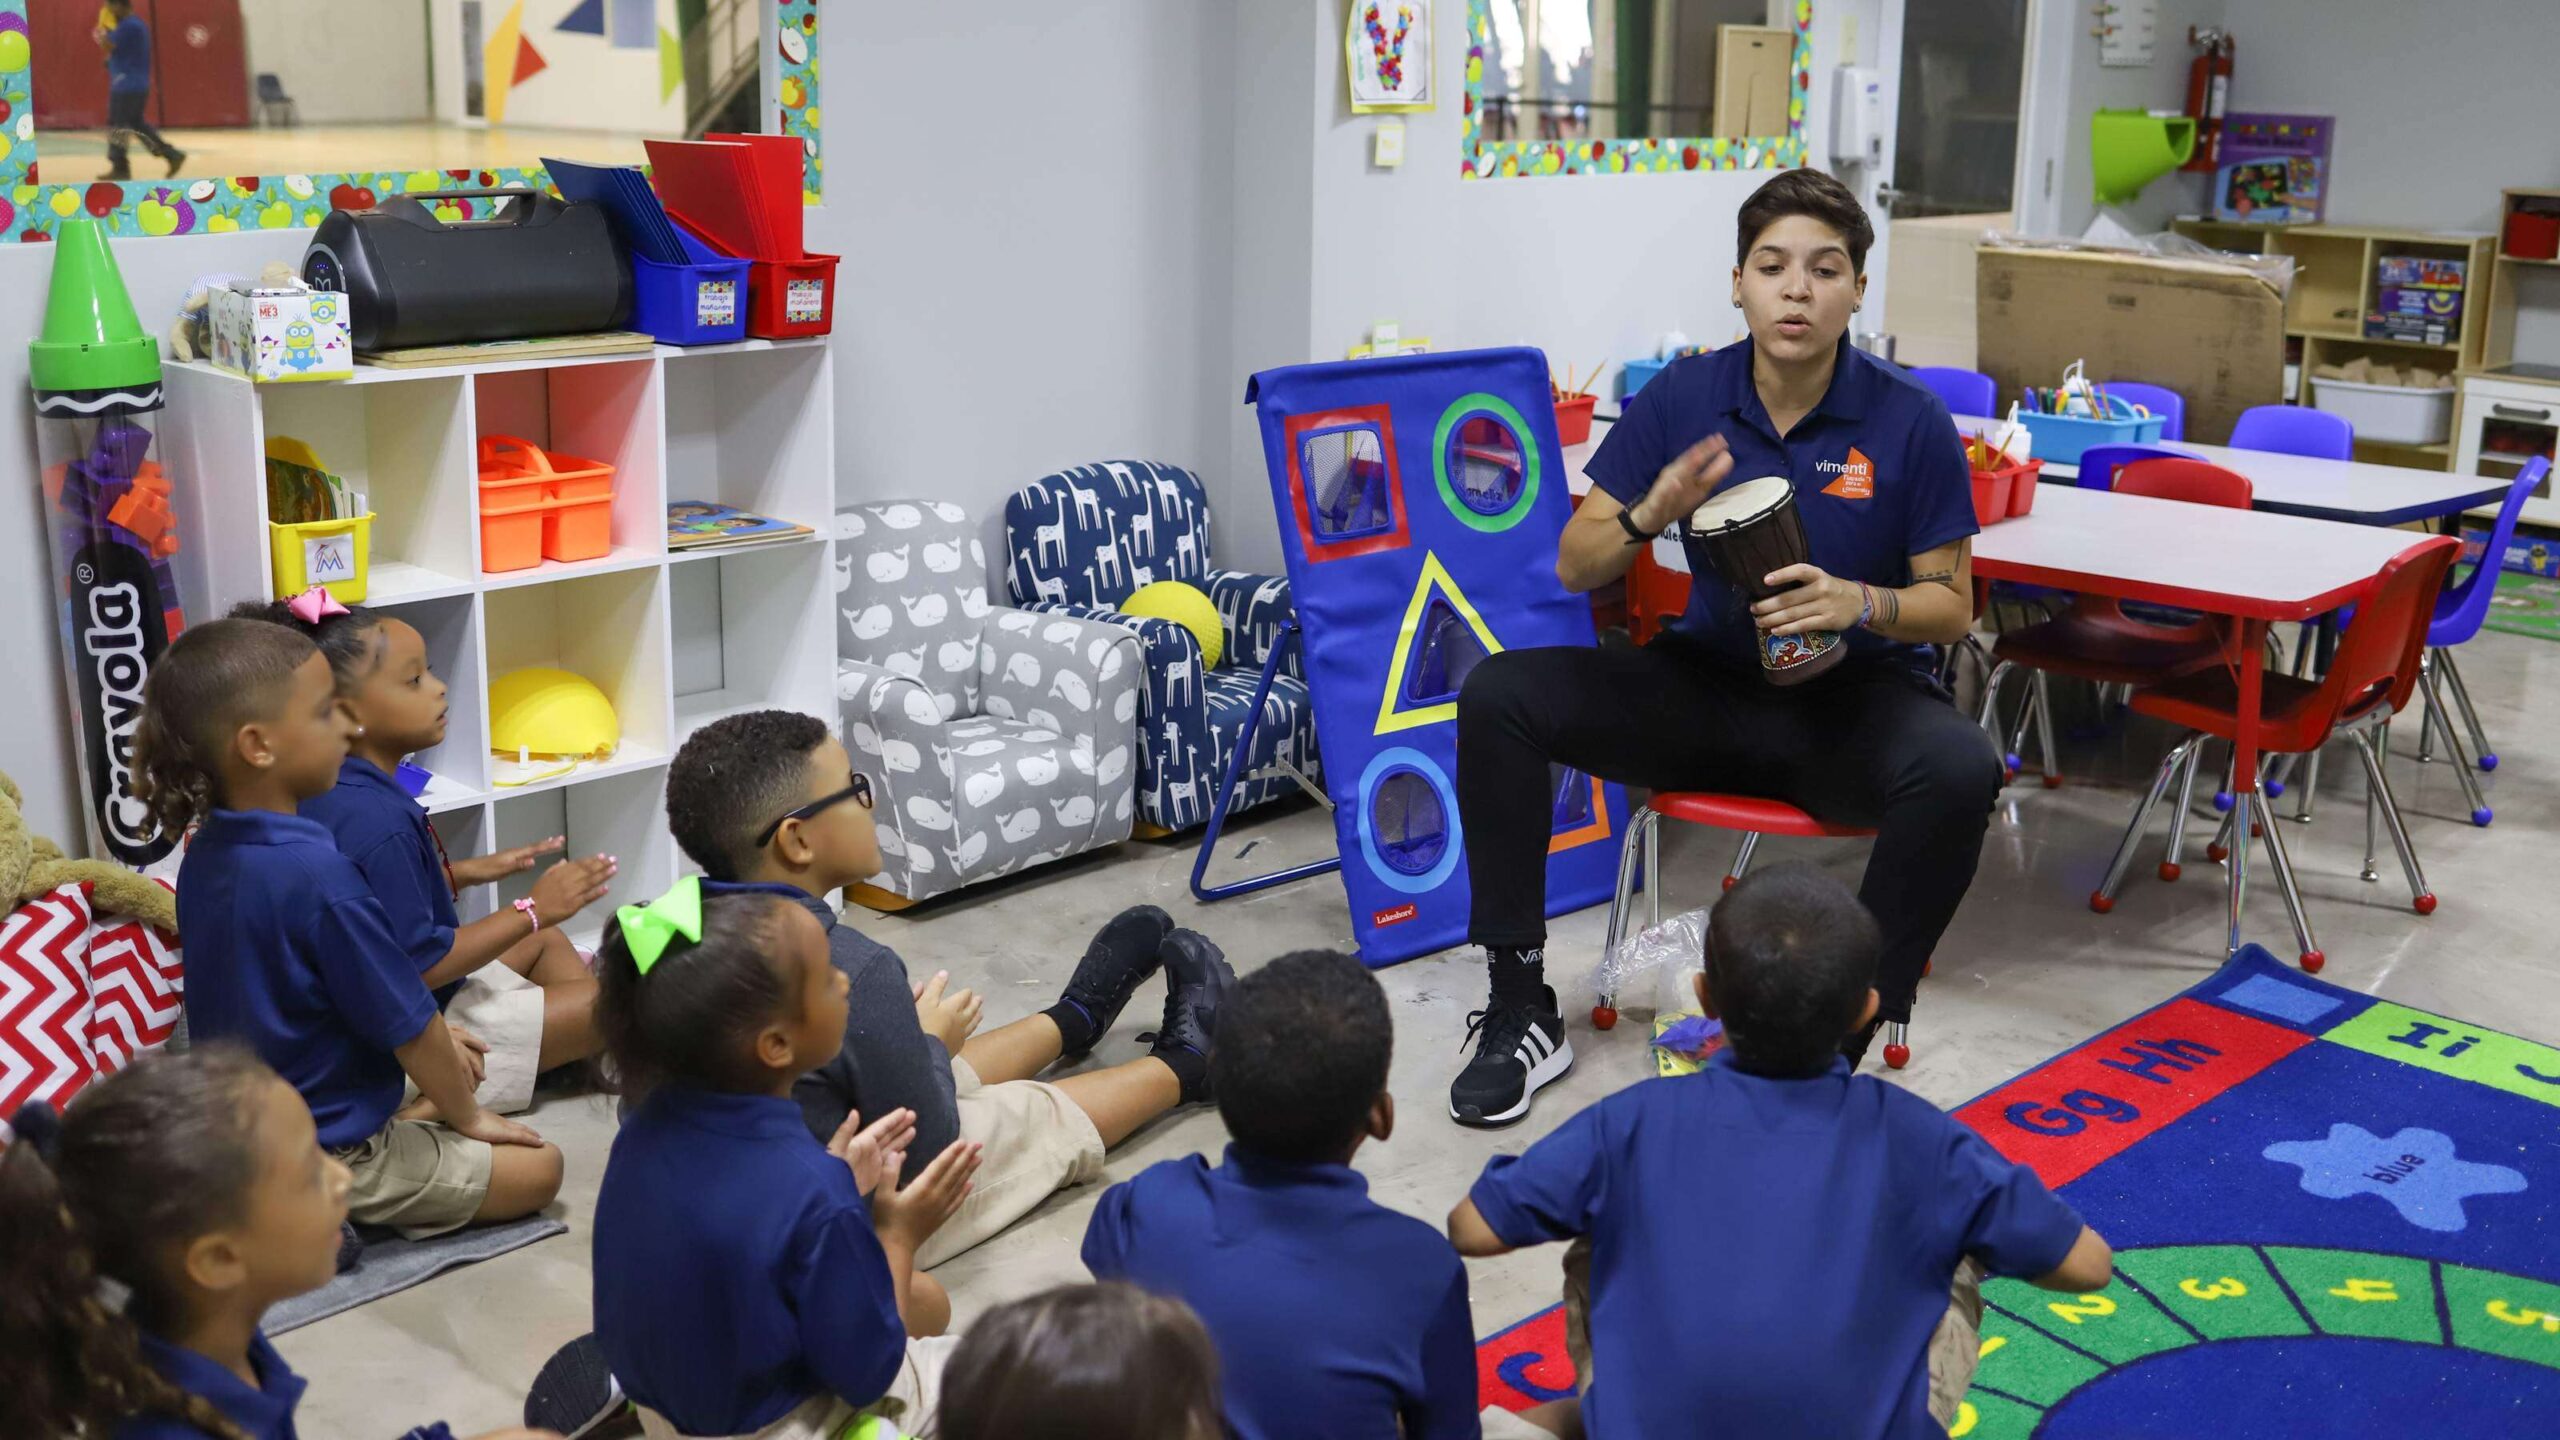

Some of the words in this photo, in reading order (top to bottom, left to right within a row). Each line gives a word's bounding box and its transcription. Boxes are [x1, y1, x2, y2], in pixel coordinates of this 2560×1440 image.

[1815, 459, 1868, 475] vimenti
[1376, 909, 1412, 925] Lakeshore
[2387, 1021, 2481, 1058] Ii
[2004, 1088, 2141, 1137] Gg
[2097, 1038, 2223, 1084] Hh
[2362, 1154, 2426, 1185] blue
[2179, 1276, 2247, 1300] 3
[2327, 1278, 2399, 1302] 4
[2048, 1294, 2118, 1324] 2
